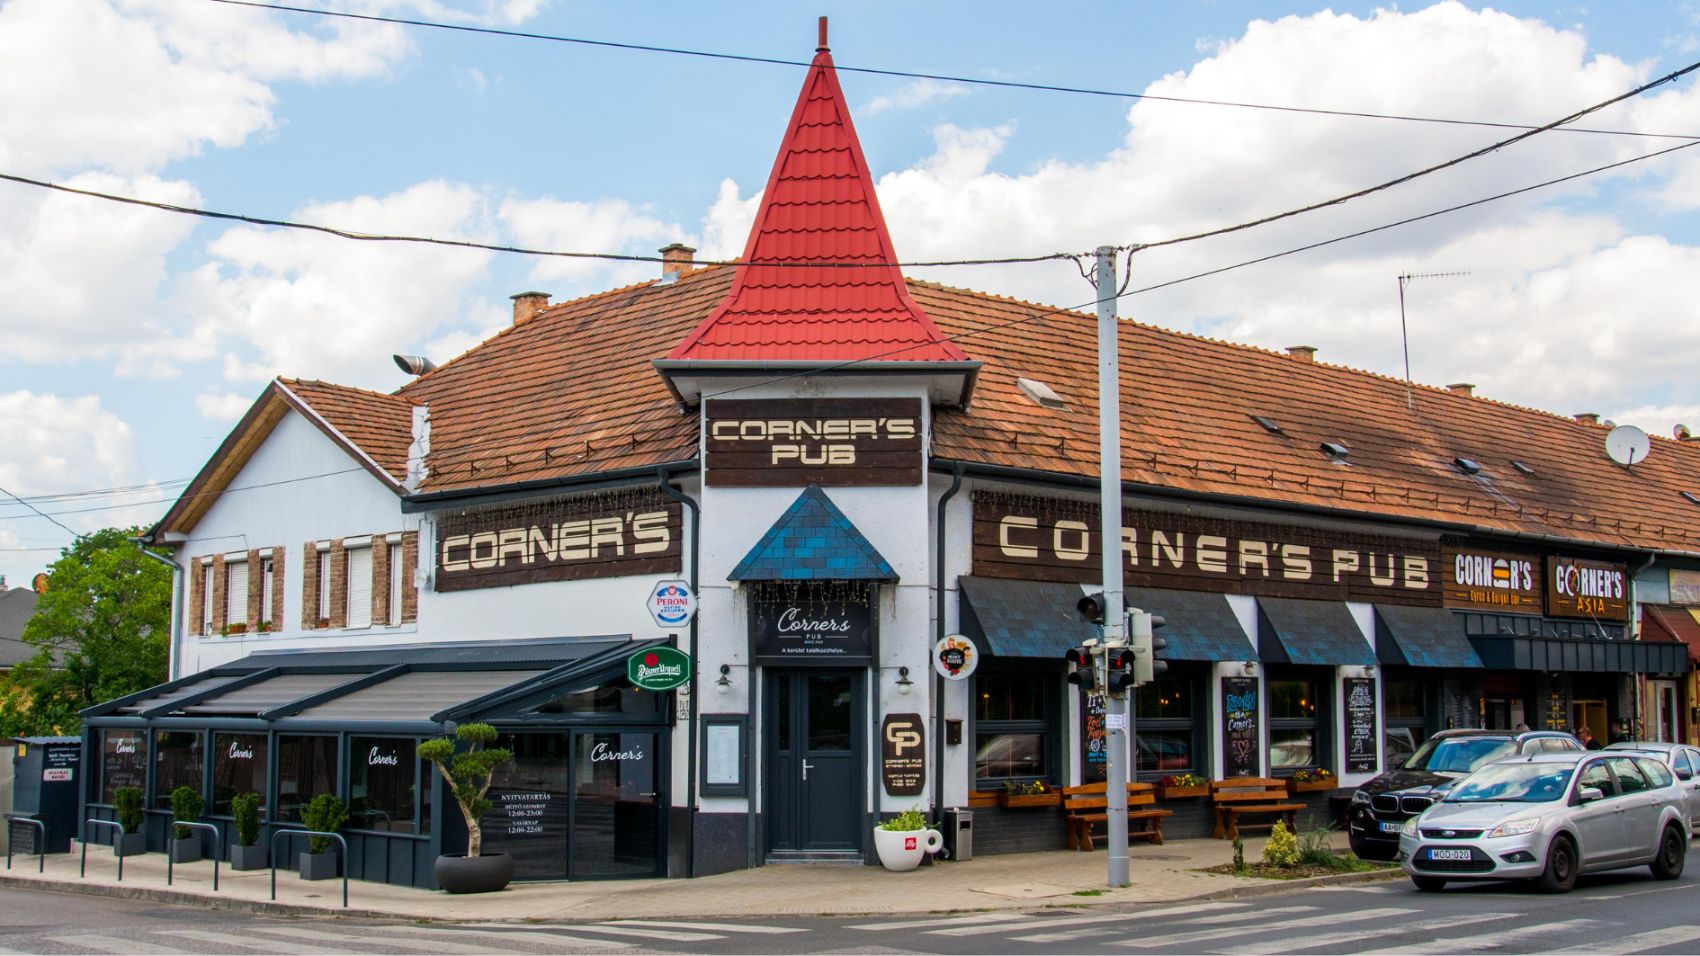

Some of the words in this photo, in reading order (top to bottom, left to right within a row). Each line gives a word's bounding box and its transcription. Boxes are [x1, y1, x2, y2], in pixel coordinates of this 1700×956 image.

[712, 418, 915, 440] CORNER'S
[771, 444, 856, 465] PUB
[442, 511, 670, 572] CORNER'S
[1333, 549, 1429, 589] PUB
[1556, 565, 1622, 598] CORNER'S
[657, 598, 688, 606] PERONI
[1577, 596, 1605, 614] ASIA
[368, 746, 398, 765] Corner's
[591, 742, 644, 762] Corner's
